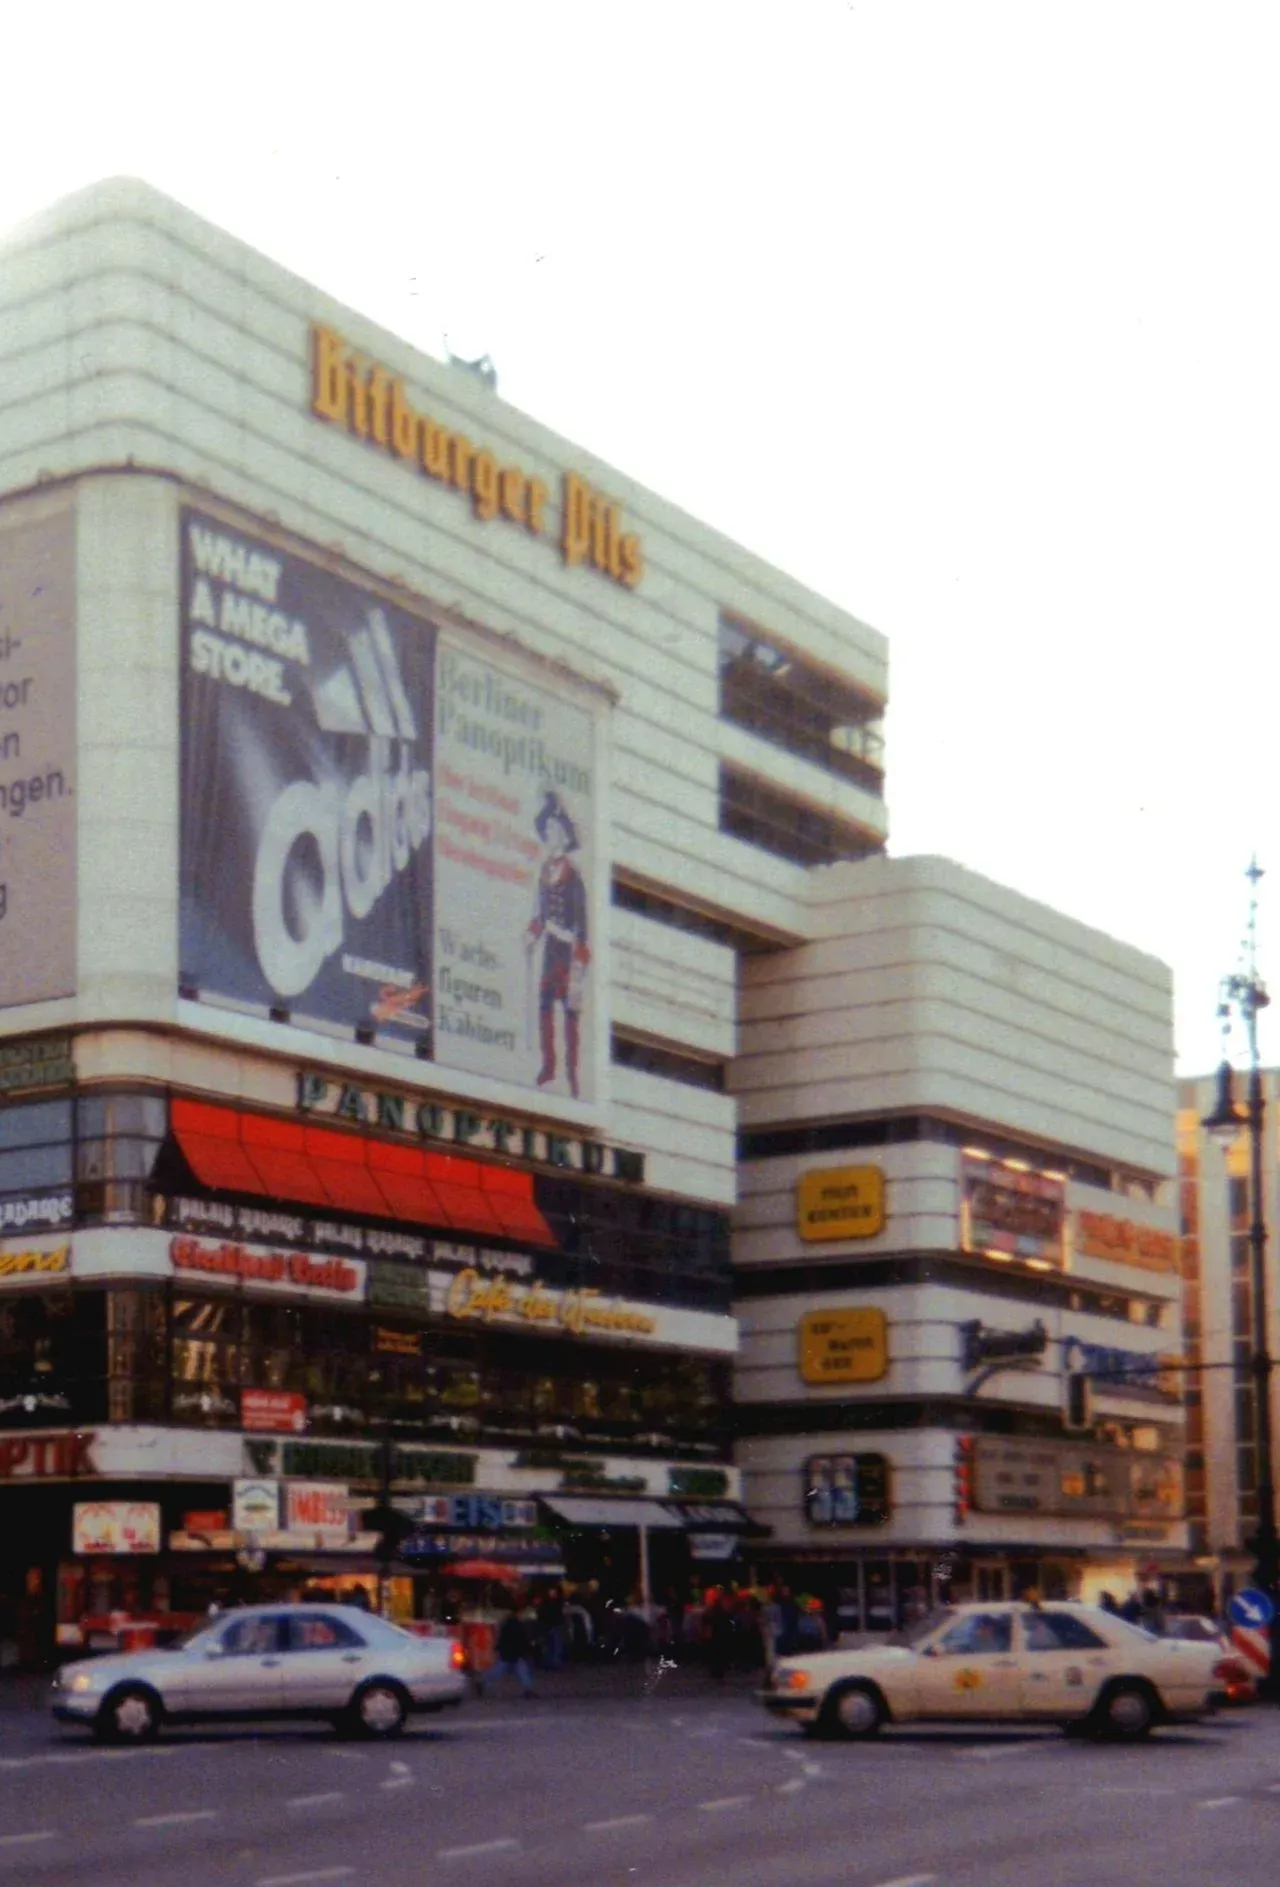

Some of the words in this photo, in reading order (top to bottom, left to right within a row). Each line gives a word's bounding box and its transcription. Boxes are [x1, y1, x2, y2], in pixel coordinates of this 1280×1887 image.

[308, 316, 549, 535] Bitburger
[561, 467, 643, 590] Pils
[189, 524, 282, 602] WHAT
[190, 577, 216, 627] A
[220, 590, 310, 666] MEGA
[439, 700, 590, 795] Panoptikum
[252, 738, 429, 997] adidas
[298, 1071, 645, 1184] PANOPTIKUM
